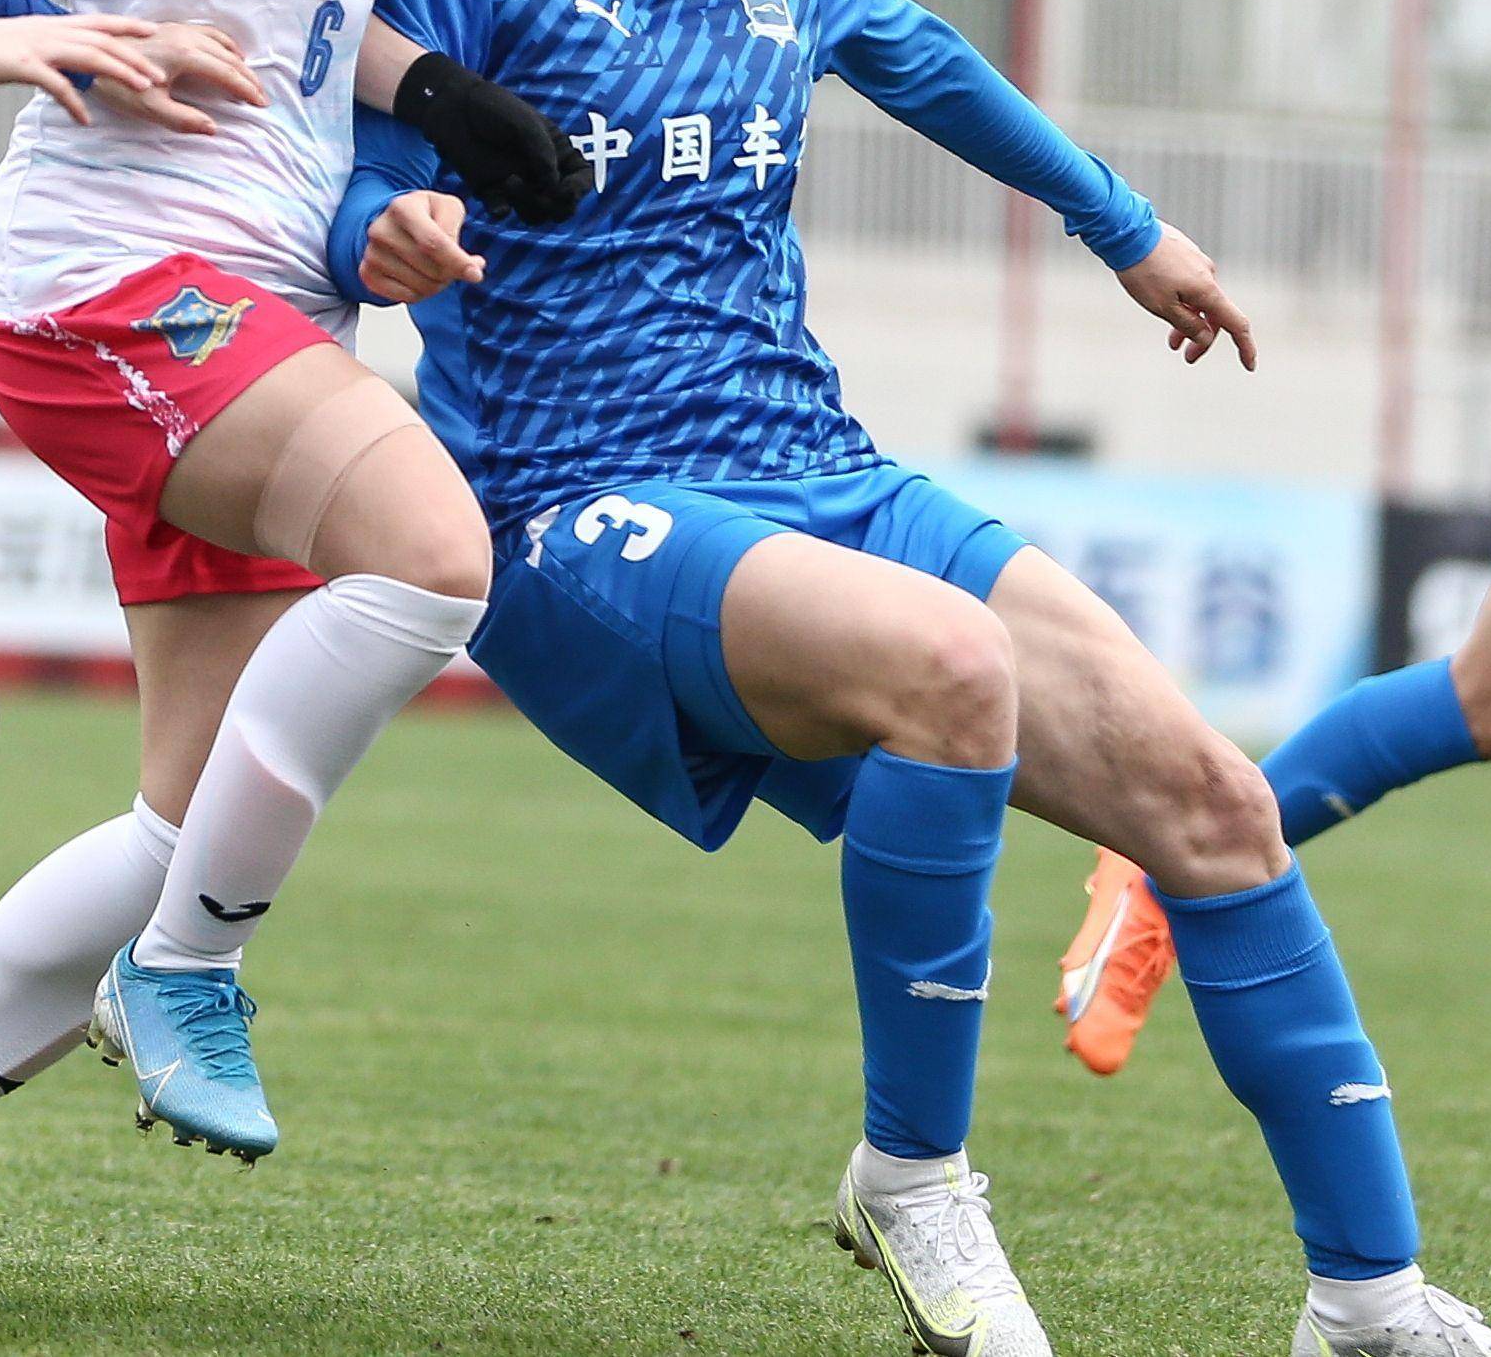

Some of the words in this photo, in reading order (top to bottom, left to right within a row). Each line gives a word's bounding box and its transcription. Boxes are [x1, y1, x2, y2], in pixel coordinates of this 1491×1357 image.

[299, 0, 345, 98] 6
[568, 103, 807, 194] 中国车
[572, 493, 675, 563] 3
